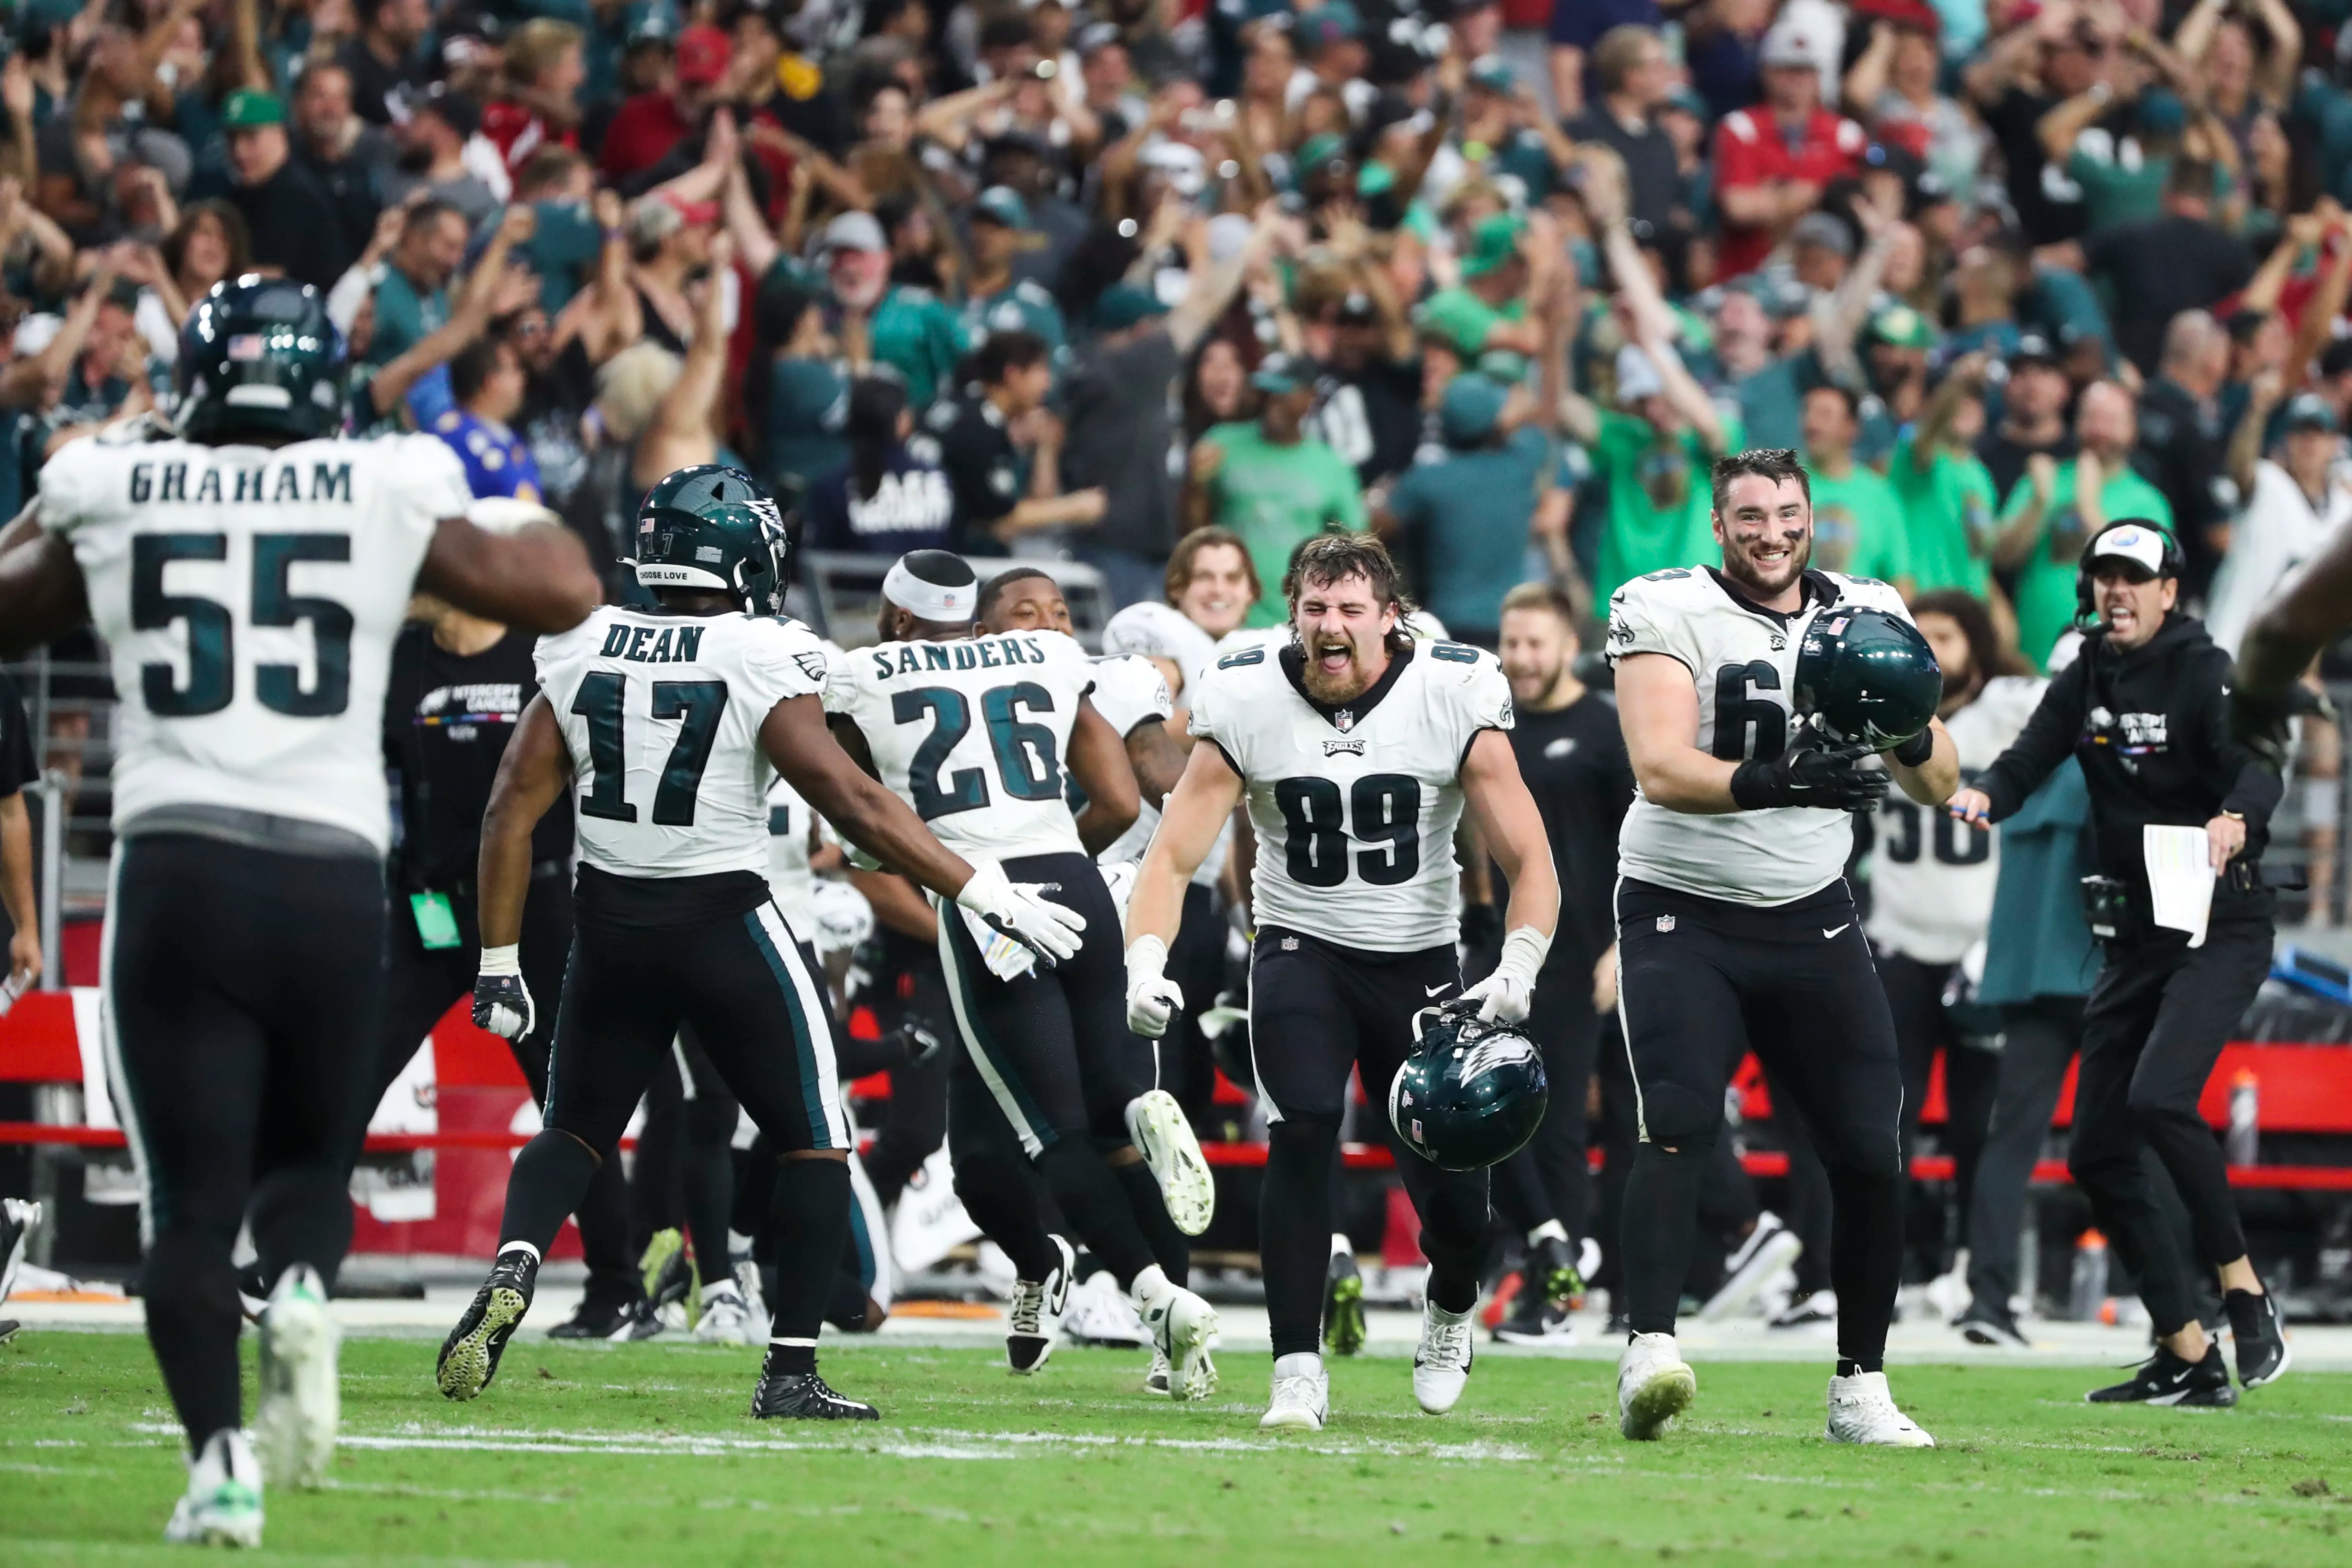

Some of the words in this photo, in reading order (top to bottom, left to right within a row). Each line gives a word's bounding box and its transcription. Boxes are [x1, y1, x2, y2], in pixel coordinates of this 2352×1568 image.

[131, 462, 353, 504] GRAHAM
[645, 533, 674, 555] 17
[131, 532, 355, 718] 55
[599, 623, 706, 663] DEAN
[872, 637, 1045, 681] SANDERS
[570, 670, 729, 827] 17
[1322, 740, 1367, 757] EAGLES
[1712, 659, 1787, 765] 6
[891, 681, 1063, 823] 26
[1274, 773, 1421, 887] 89
